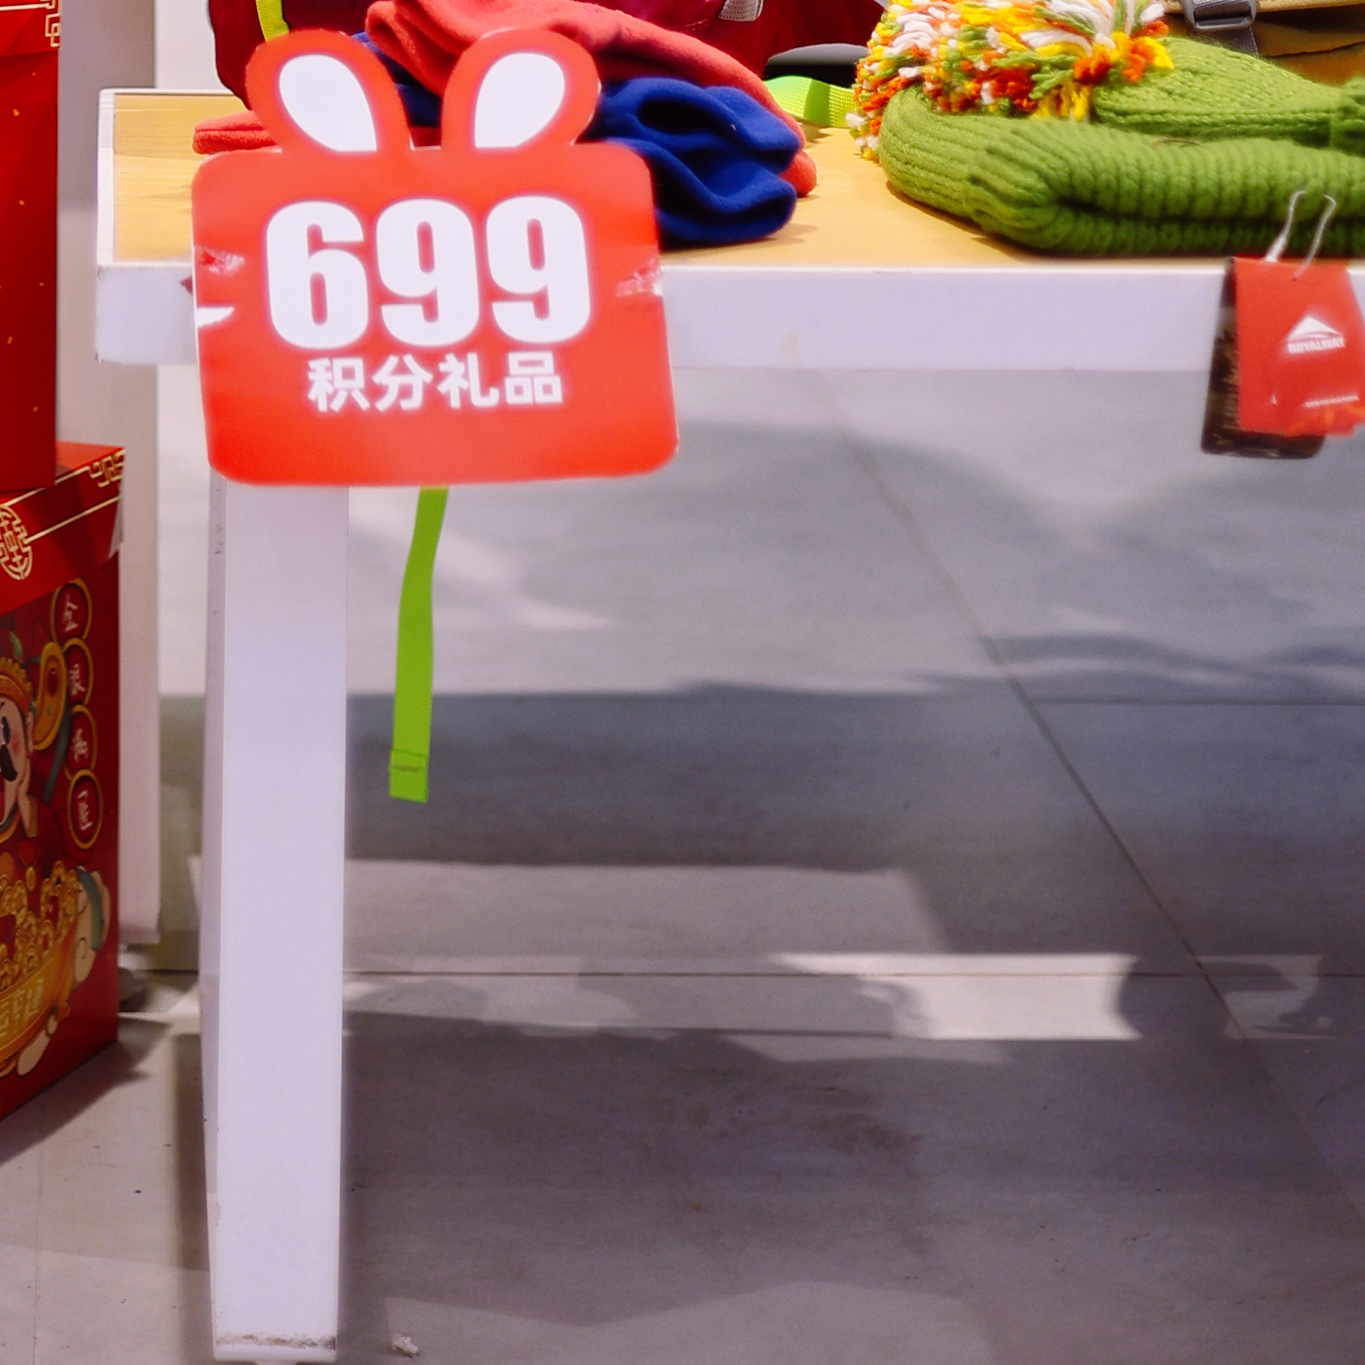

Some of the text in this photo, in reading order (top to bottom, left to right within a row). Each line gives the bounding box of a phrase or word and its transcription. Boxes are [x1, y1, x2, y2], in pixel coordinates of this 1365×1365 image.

[266, 196, 591, 349] 699
[307, 352, 563, 412] 积分礼品
